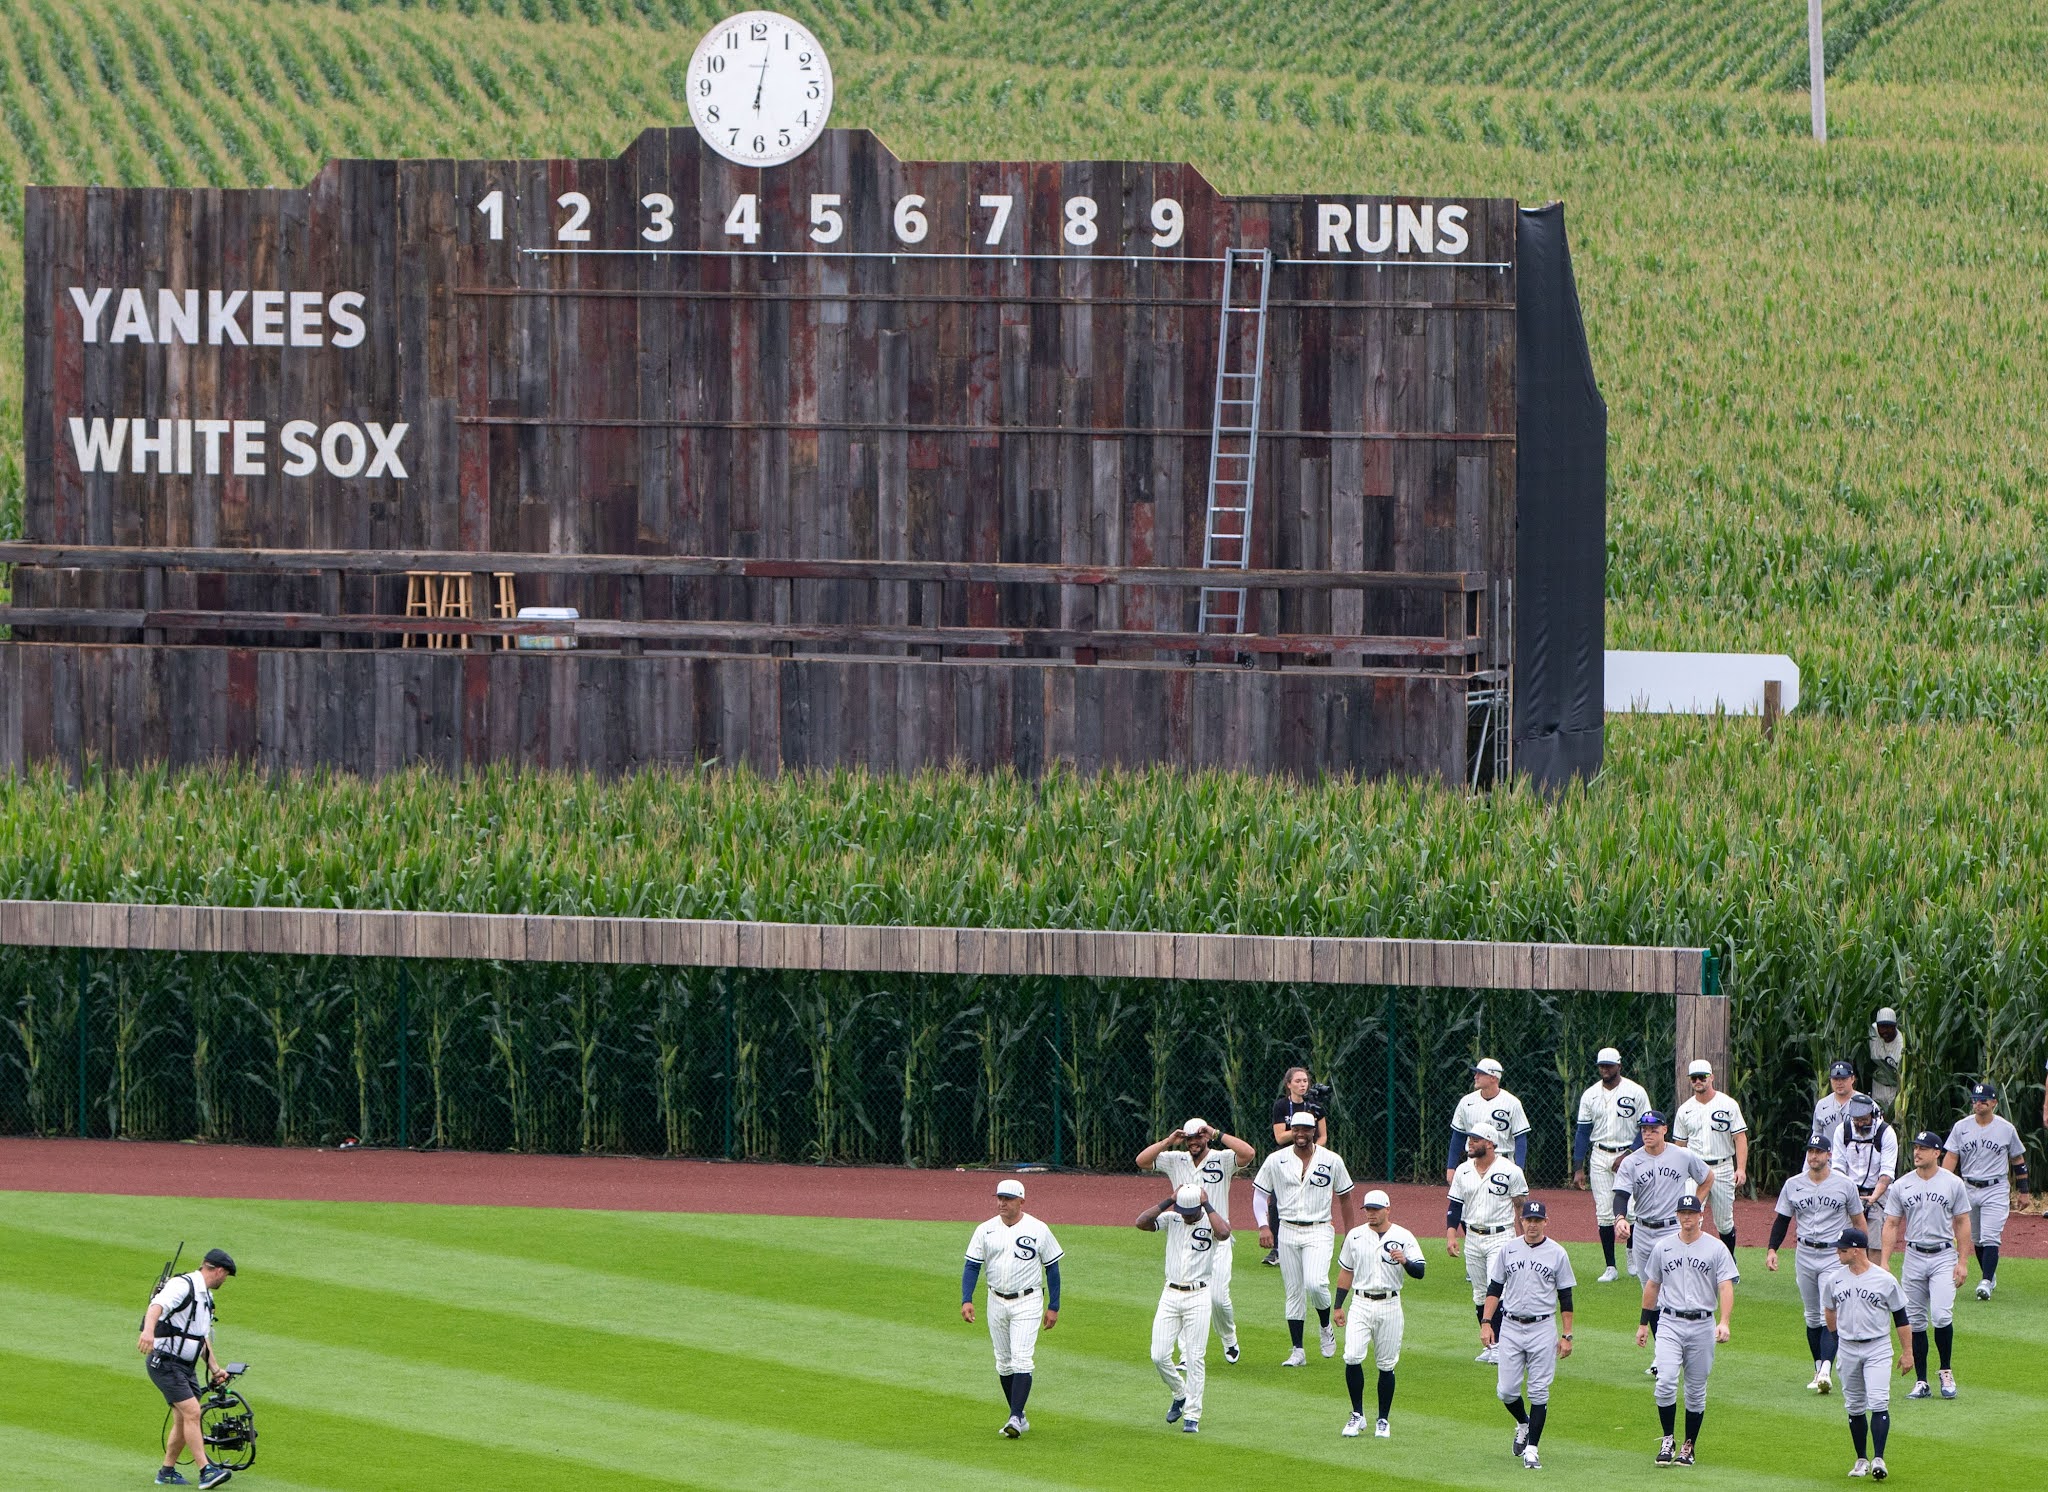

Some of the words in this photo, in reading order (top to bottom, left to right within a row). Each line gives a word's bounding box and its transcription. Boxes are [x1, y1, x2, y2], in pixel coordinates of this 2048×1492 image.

[727, 32, 738, 49] 11
[751, 24, 768, 41] 12
[707, 55, 725, 73] 10
[799, 52, 812, 70] 2
[700, 79, 712, 96] 9
[807, 81, 820, 99] 3
[707, 105, 720, 123] 8
[796, 110, 811, 127] 4
[728, 128, 740, 146] 7
[753, 135, 765, 153] 6
[778, 129, 790, 147] 5
[477, 190, 503, 240] 1
[556, 191, 591, 241] 2
[641, 193, 675, 243] 3
[724, 194, 761, 244] 4
[809, 194, 844, 244] 5
[893, 194, 928, 244] 6
[979, 195, 1013, 245] 7
[1064, 196, 1098, 246] 8
[1151, 198, 1184, 248] 9
[1317, 203, 1469, 255] RUNS
[68, 287, 366, 348] YANKEES
[68, 417, 266, 476] WHITE
[280, 420, 410, 479] SOX
[1961, 1140, 1977, 1155] NEW
[1981, 1139, 2004, 1156] YORK
[1636, 1169, 1654, 1187] NEW
[1658, 1167, 1681, 1182] YORK
[1795, 1197, 1813, 1212] NEW
[1817, 1196, 1842, 1212] YORK
[1903, 1193, 1922, 1210] NEW
[1926, 1192, 1949, 1209] YORK
[1505, 1260, 1525, 1278] NEW
[1530, 1260, 1552, 1280] YORK
[1663, 1258, 1683, 1275] NEW
[1687, 1257, 1712, 1276] YORK
[1856, 1287, 1881, 1307] YORK
